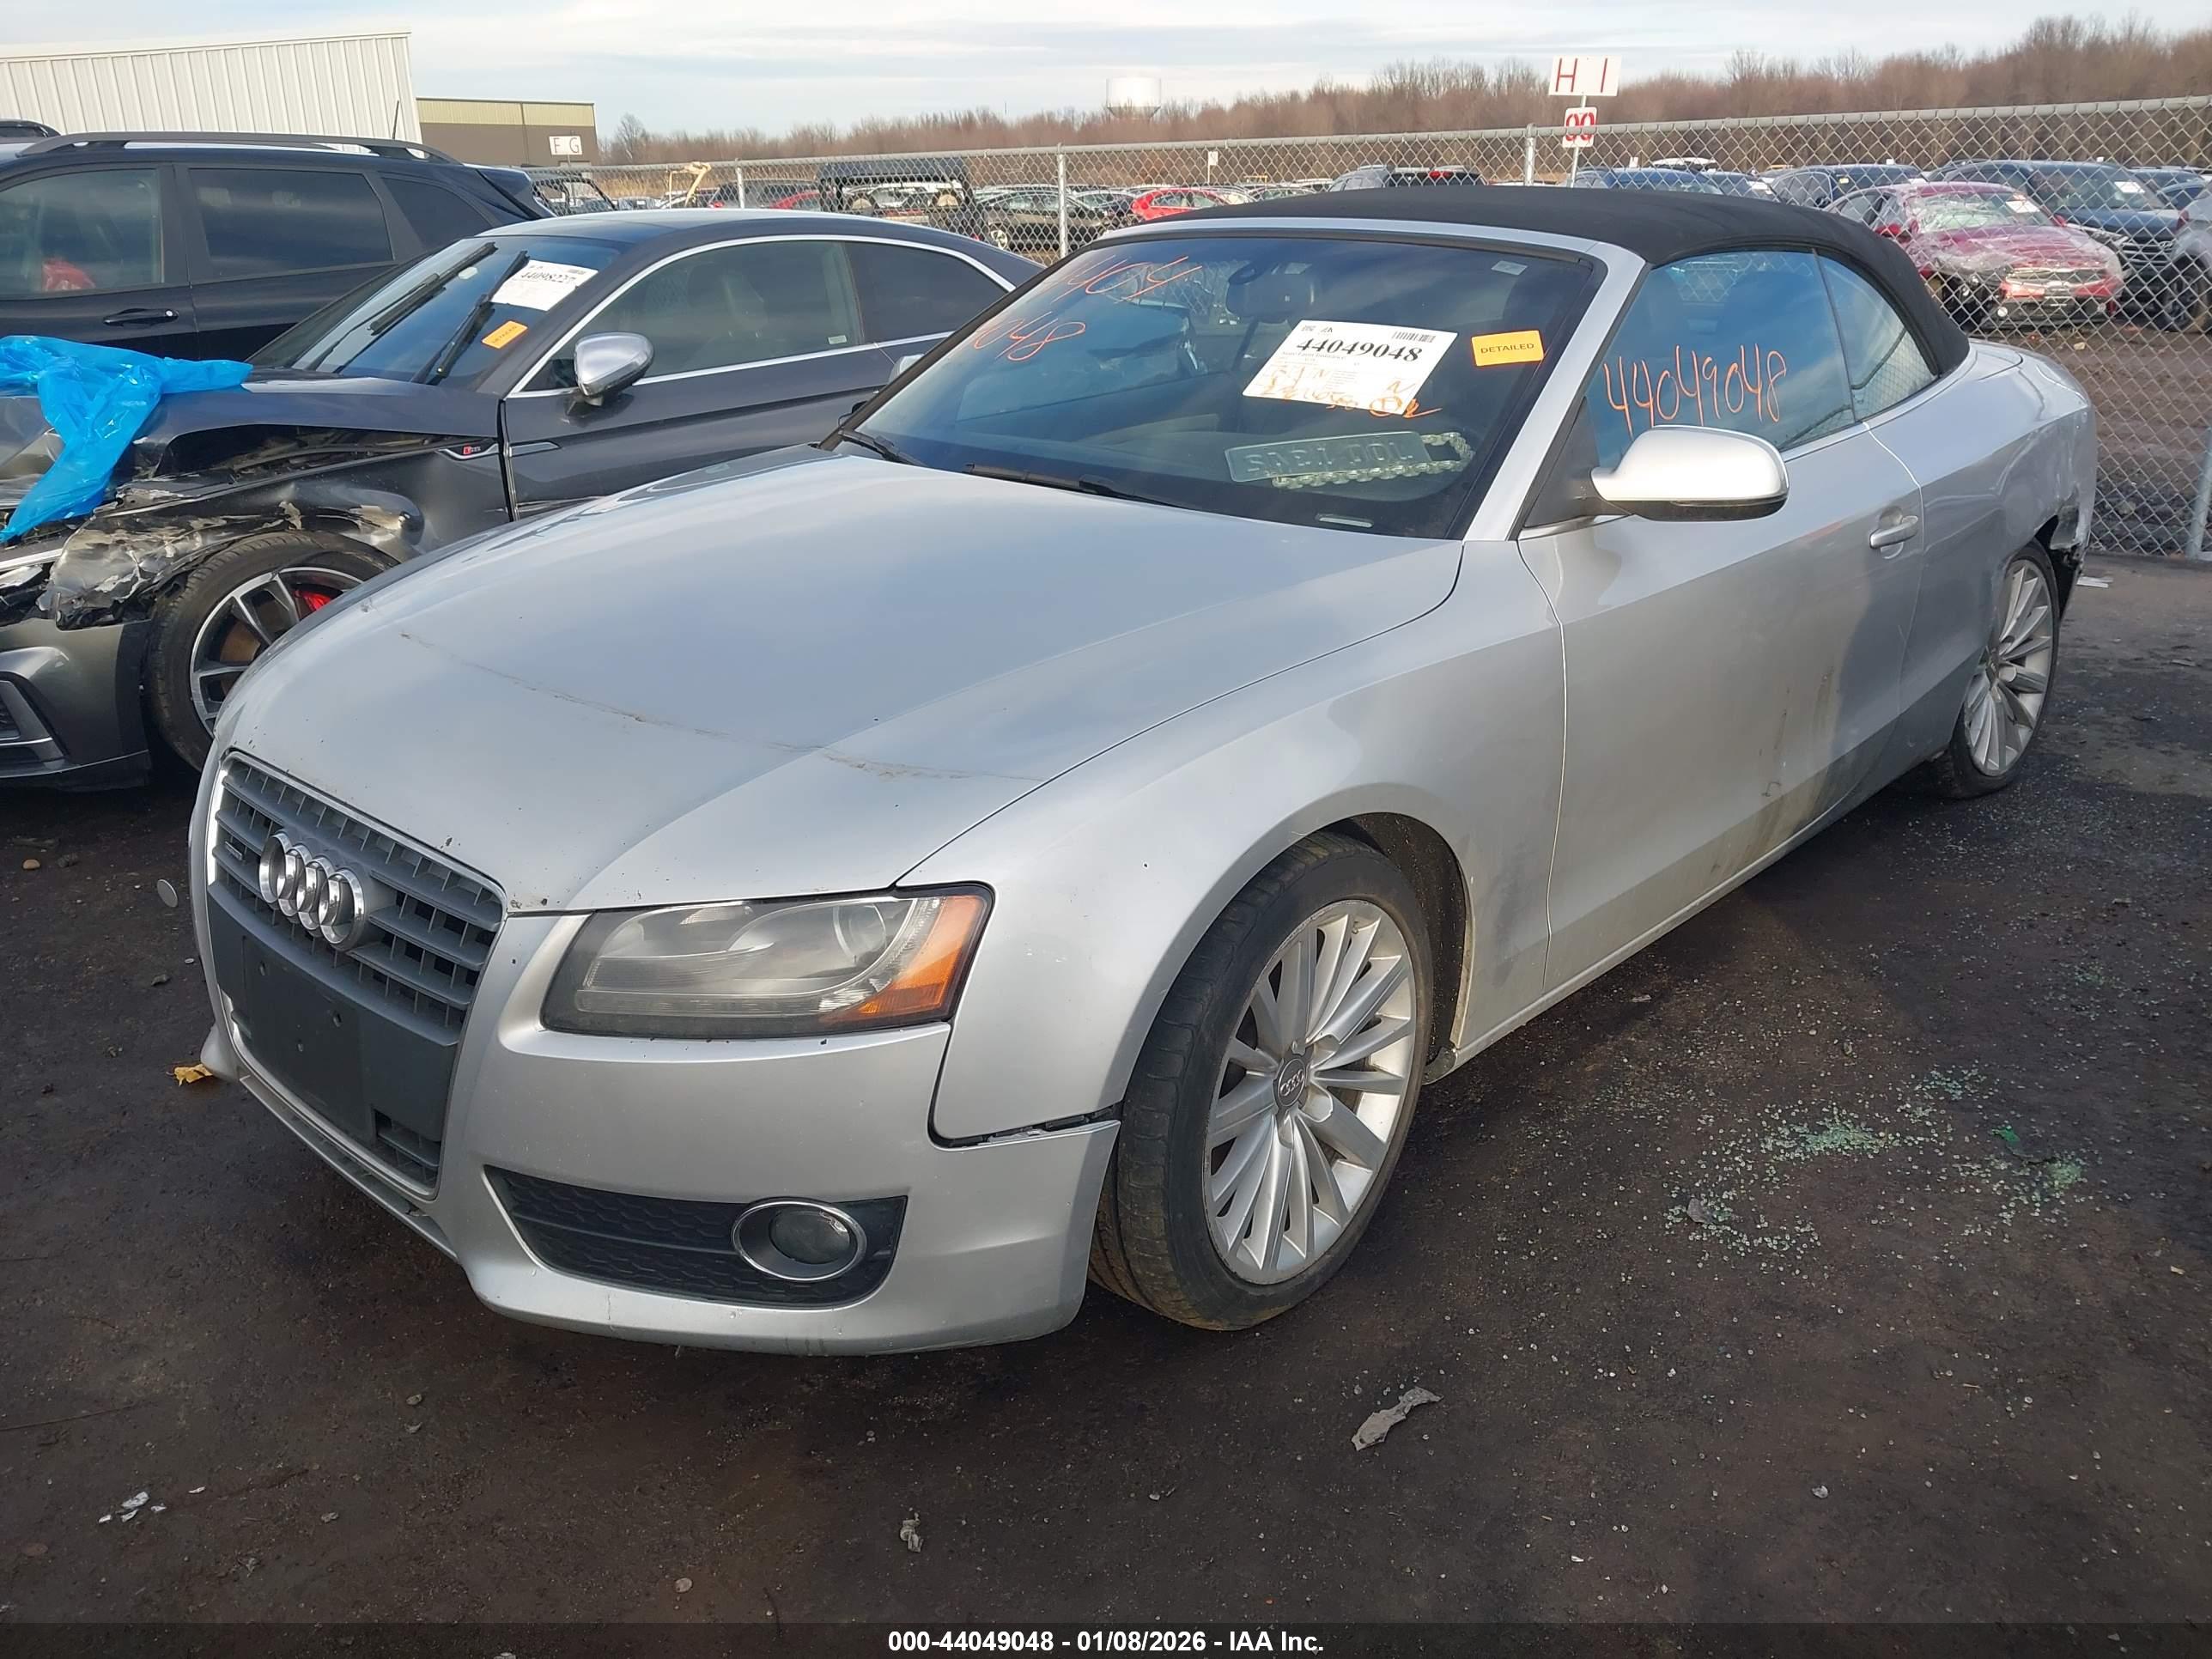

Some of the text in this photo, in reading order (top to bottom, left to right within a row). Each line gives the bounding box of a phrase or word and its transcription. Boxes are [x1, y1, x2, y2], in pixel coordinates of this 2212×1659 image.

[1555, 58, 1577, 92] H
[1565, 112, 1595, 142] 00
[553, 137, 579, 154] F G
[1297, 337, 1422, 362] 44049048
[1480, 343, 1534, 354] DETAILED
[1604, 343, 1786, 440] 44049048
